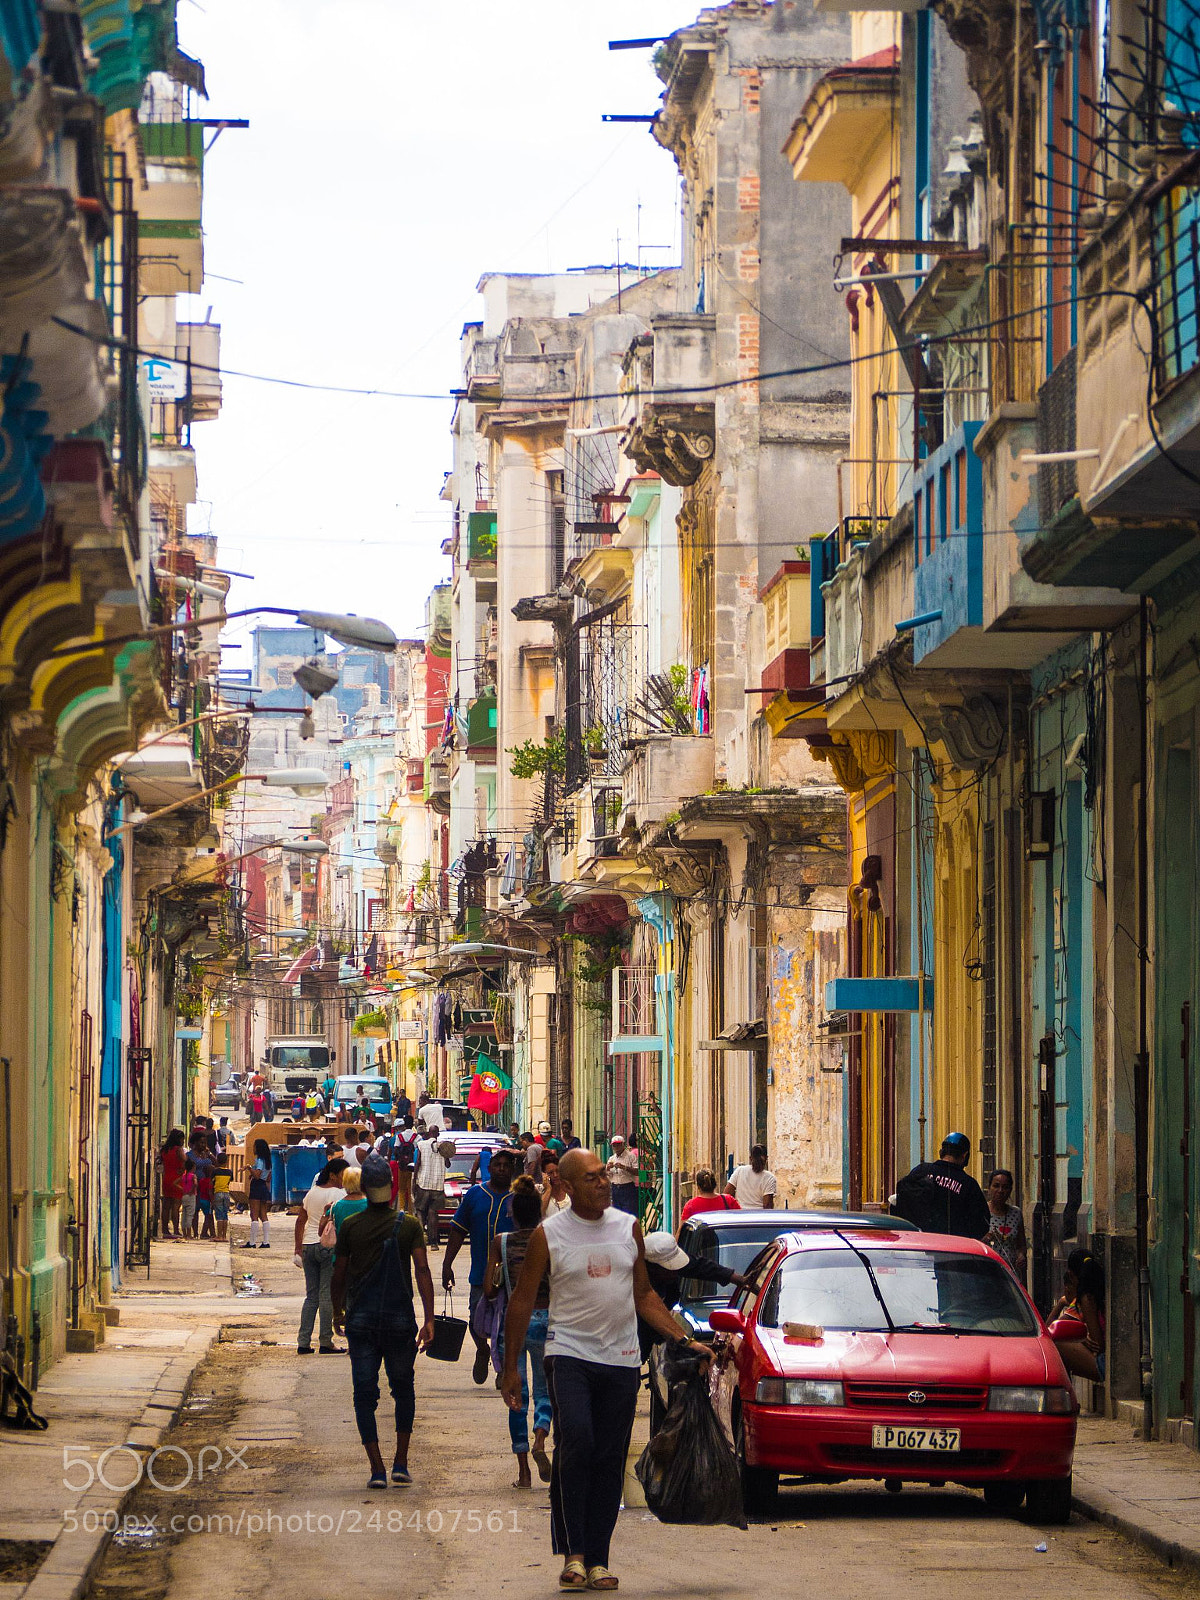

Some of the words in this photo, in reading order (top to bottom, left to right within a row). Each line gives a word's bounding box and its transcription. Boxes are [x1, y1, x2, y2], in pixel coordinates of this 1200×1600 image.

[935, 1175, 963, 1195] CATANIA
[884, 1430, 895, 1447] P
[897, 1430, 926, 1448] 067
[929, 1431, 958, 1450] 437
